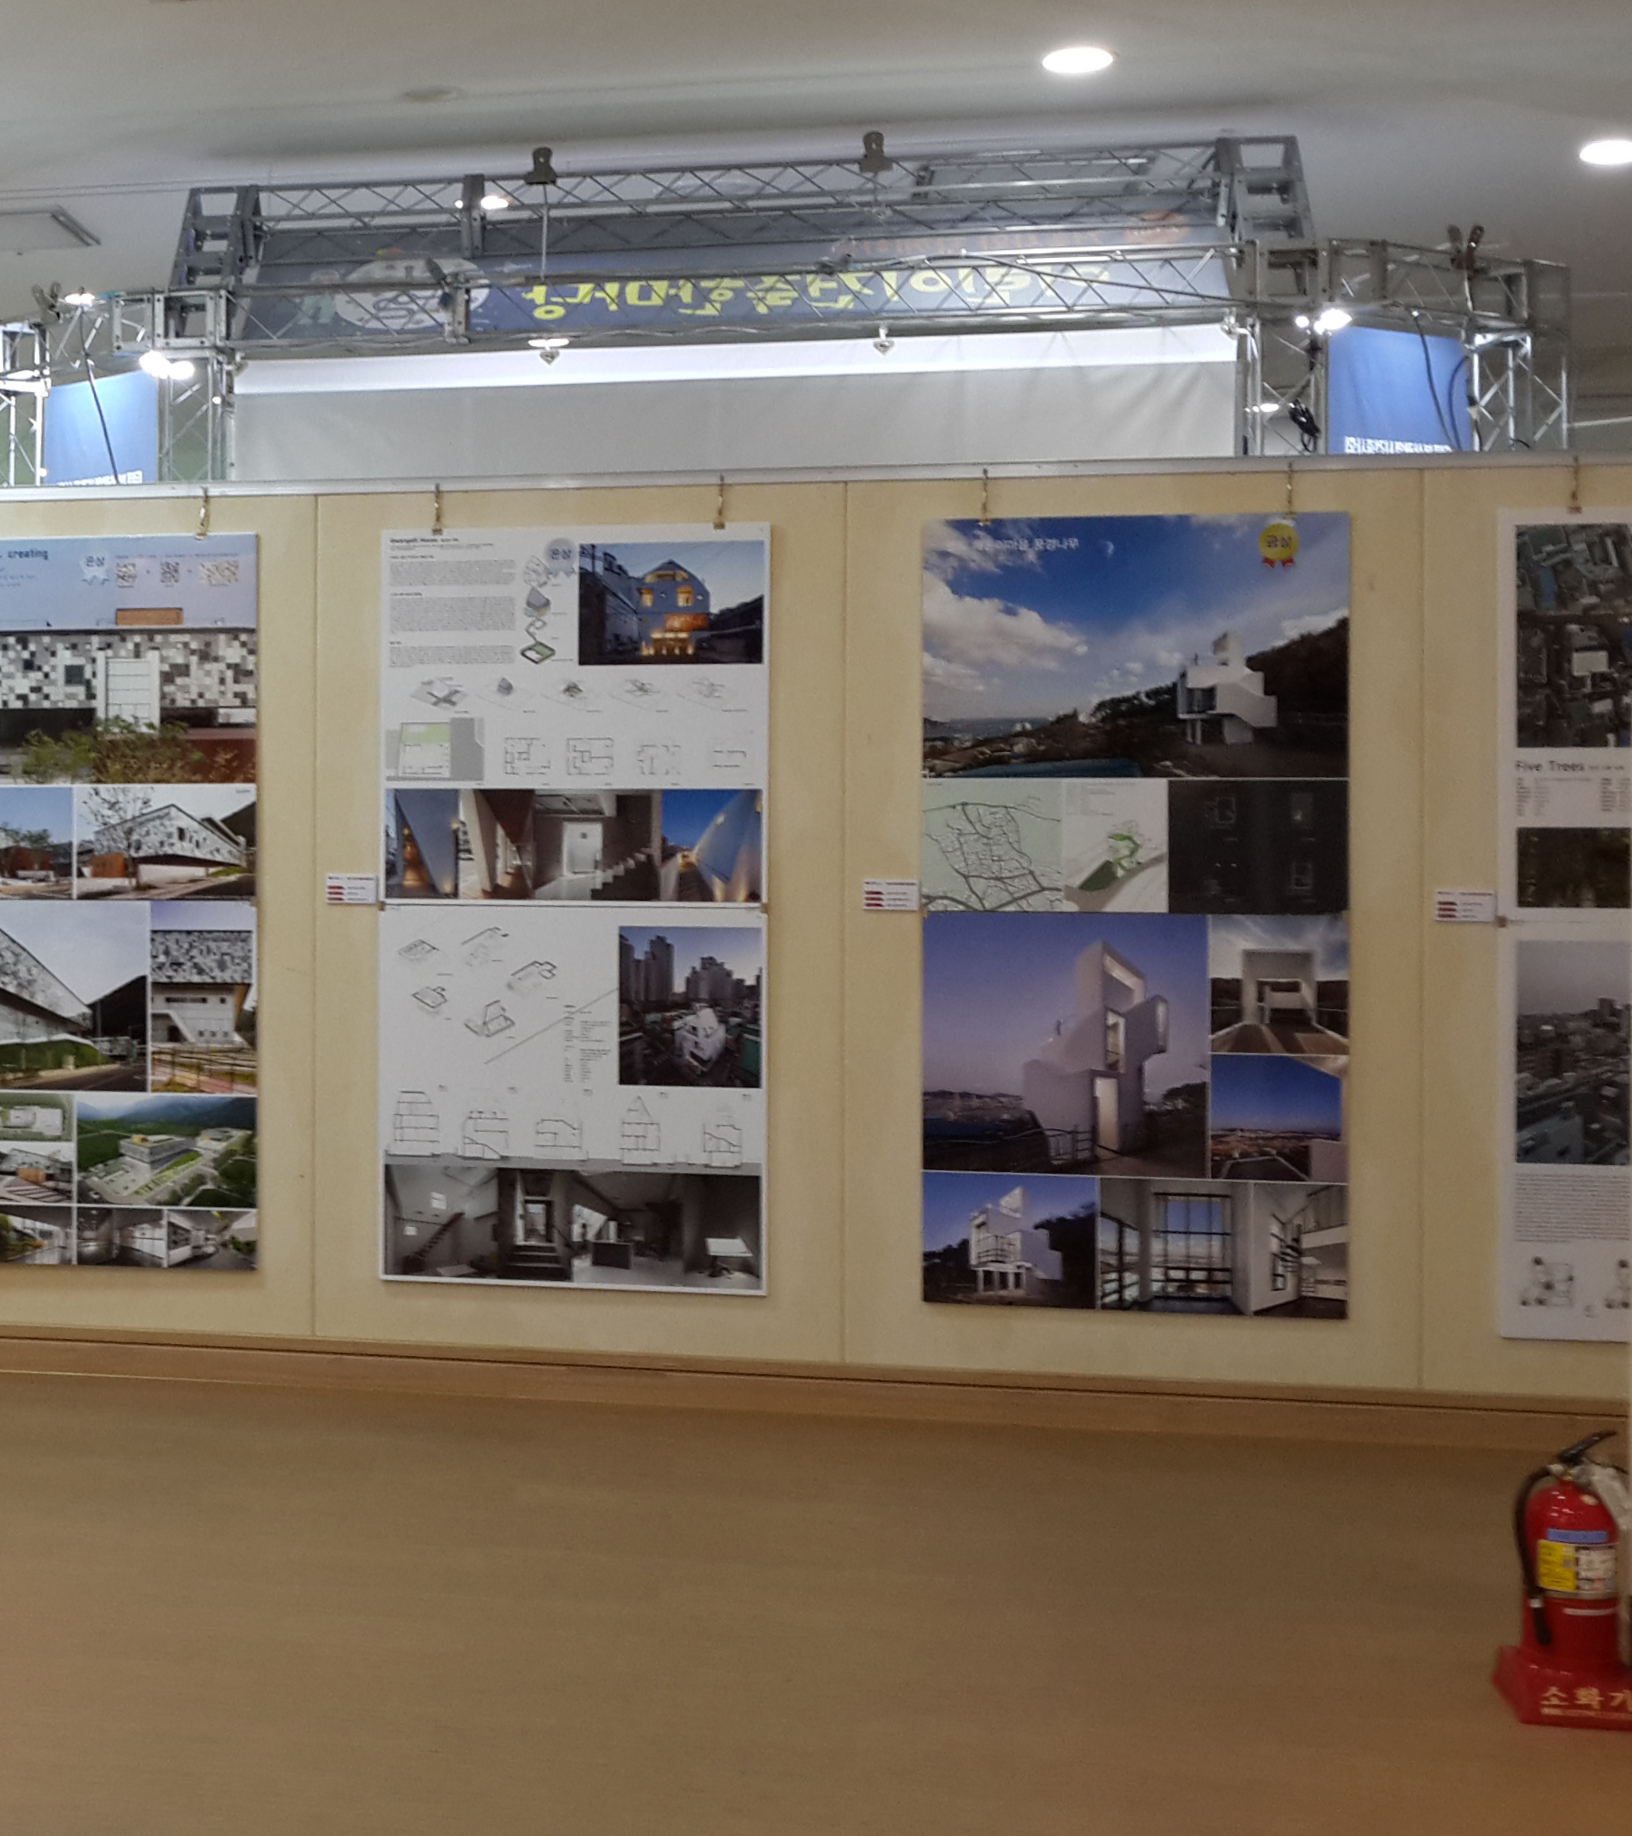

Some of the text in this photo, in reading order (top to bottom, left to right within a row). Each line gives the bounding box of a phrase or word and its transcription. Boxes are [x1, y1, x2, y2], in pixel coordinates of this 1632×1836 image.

[8, 548, 48, 561] creating
[1515, 760, 1543, 771] Five
[1548, 760, 1586, 771] Trees
[1540, 1686, 1632, 1711] 소화기
